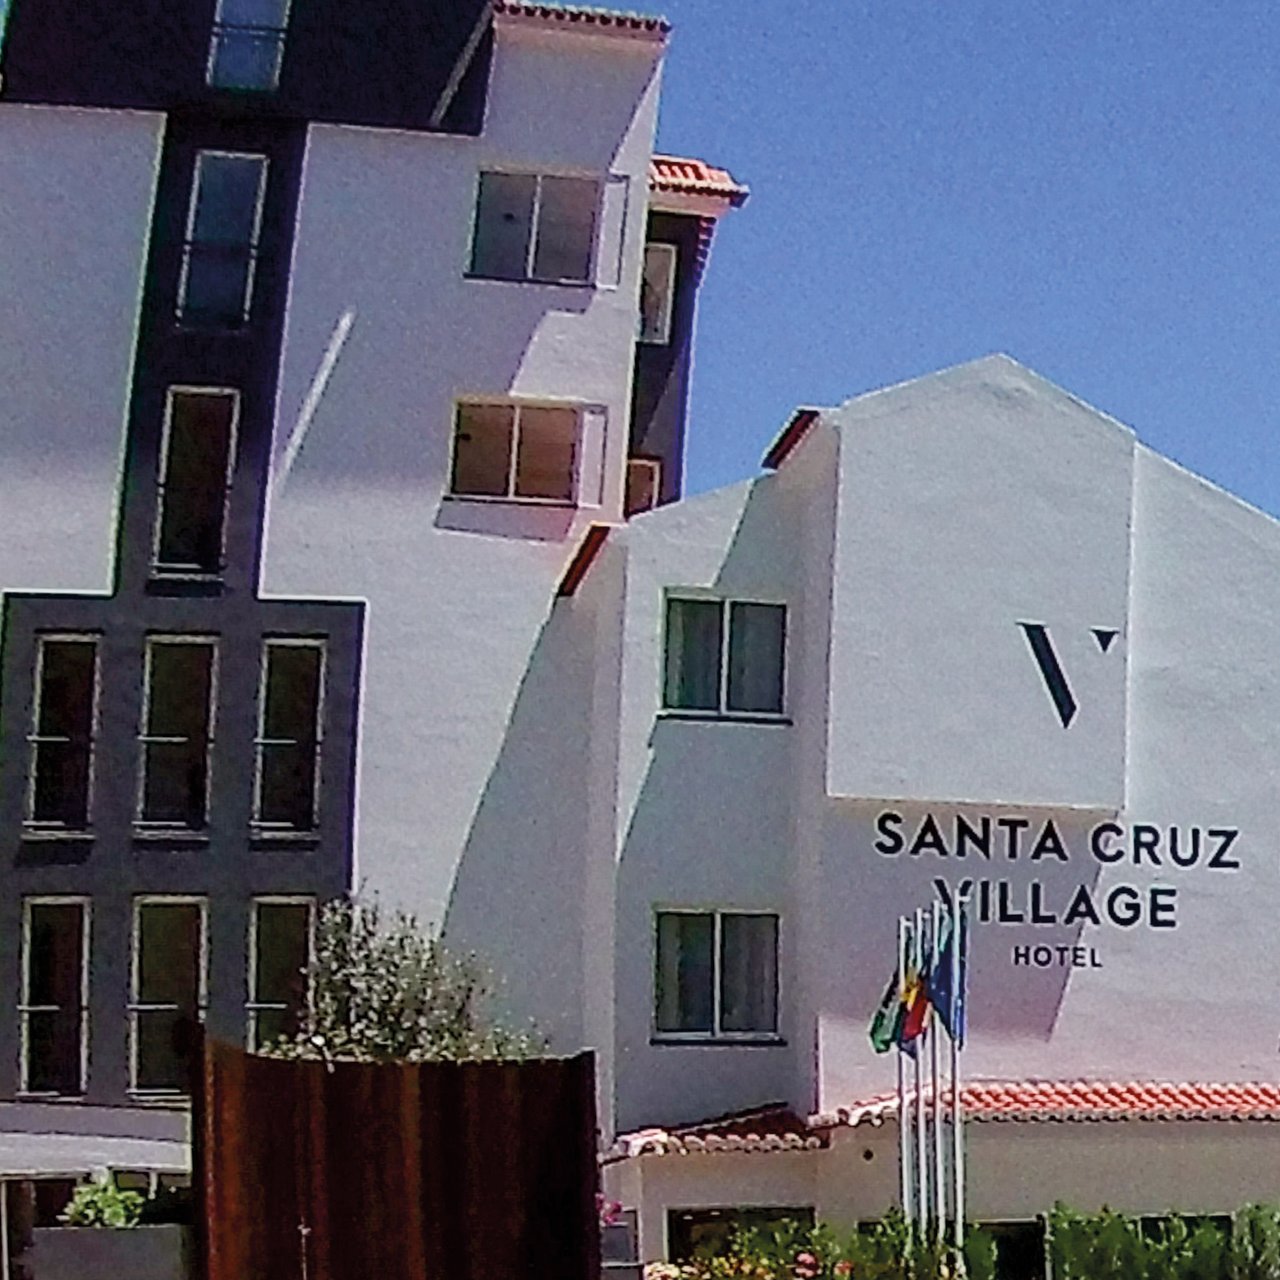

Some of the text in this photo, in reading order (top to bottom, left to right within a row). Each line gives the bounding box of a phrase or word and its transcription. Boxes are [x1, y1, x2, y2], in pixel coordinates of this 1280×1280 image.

[875, 812, 1240, 869] SANTA CRUZ
[1013, 945, 1102, 968] HOTEL
